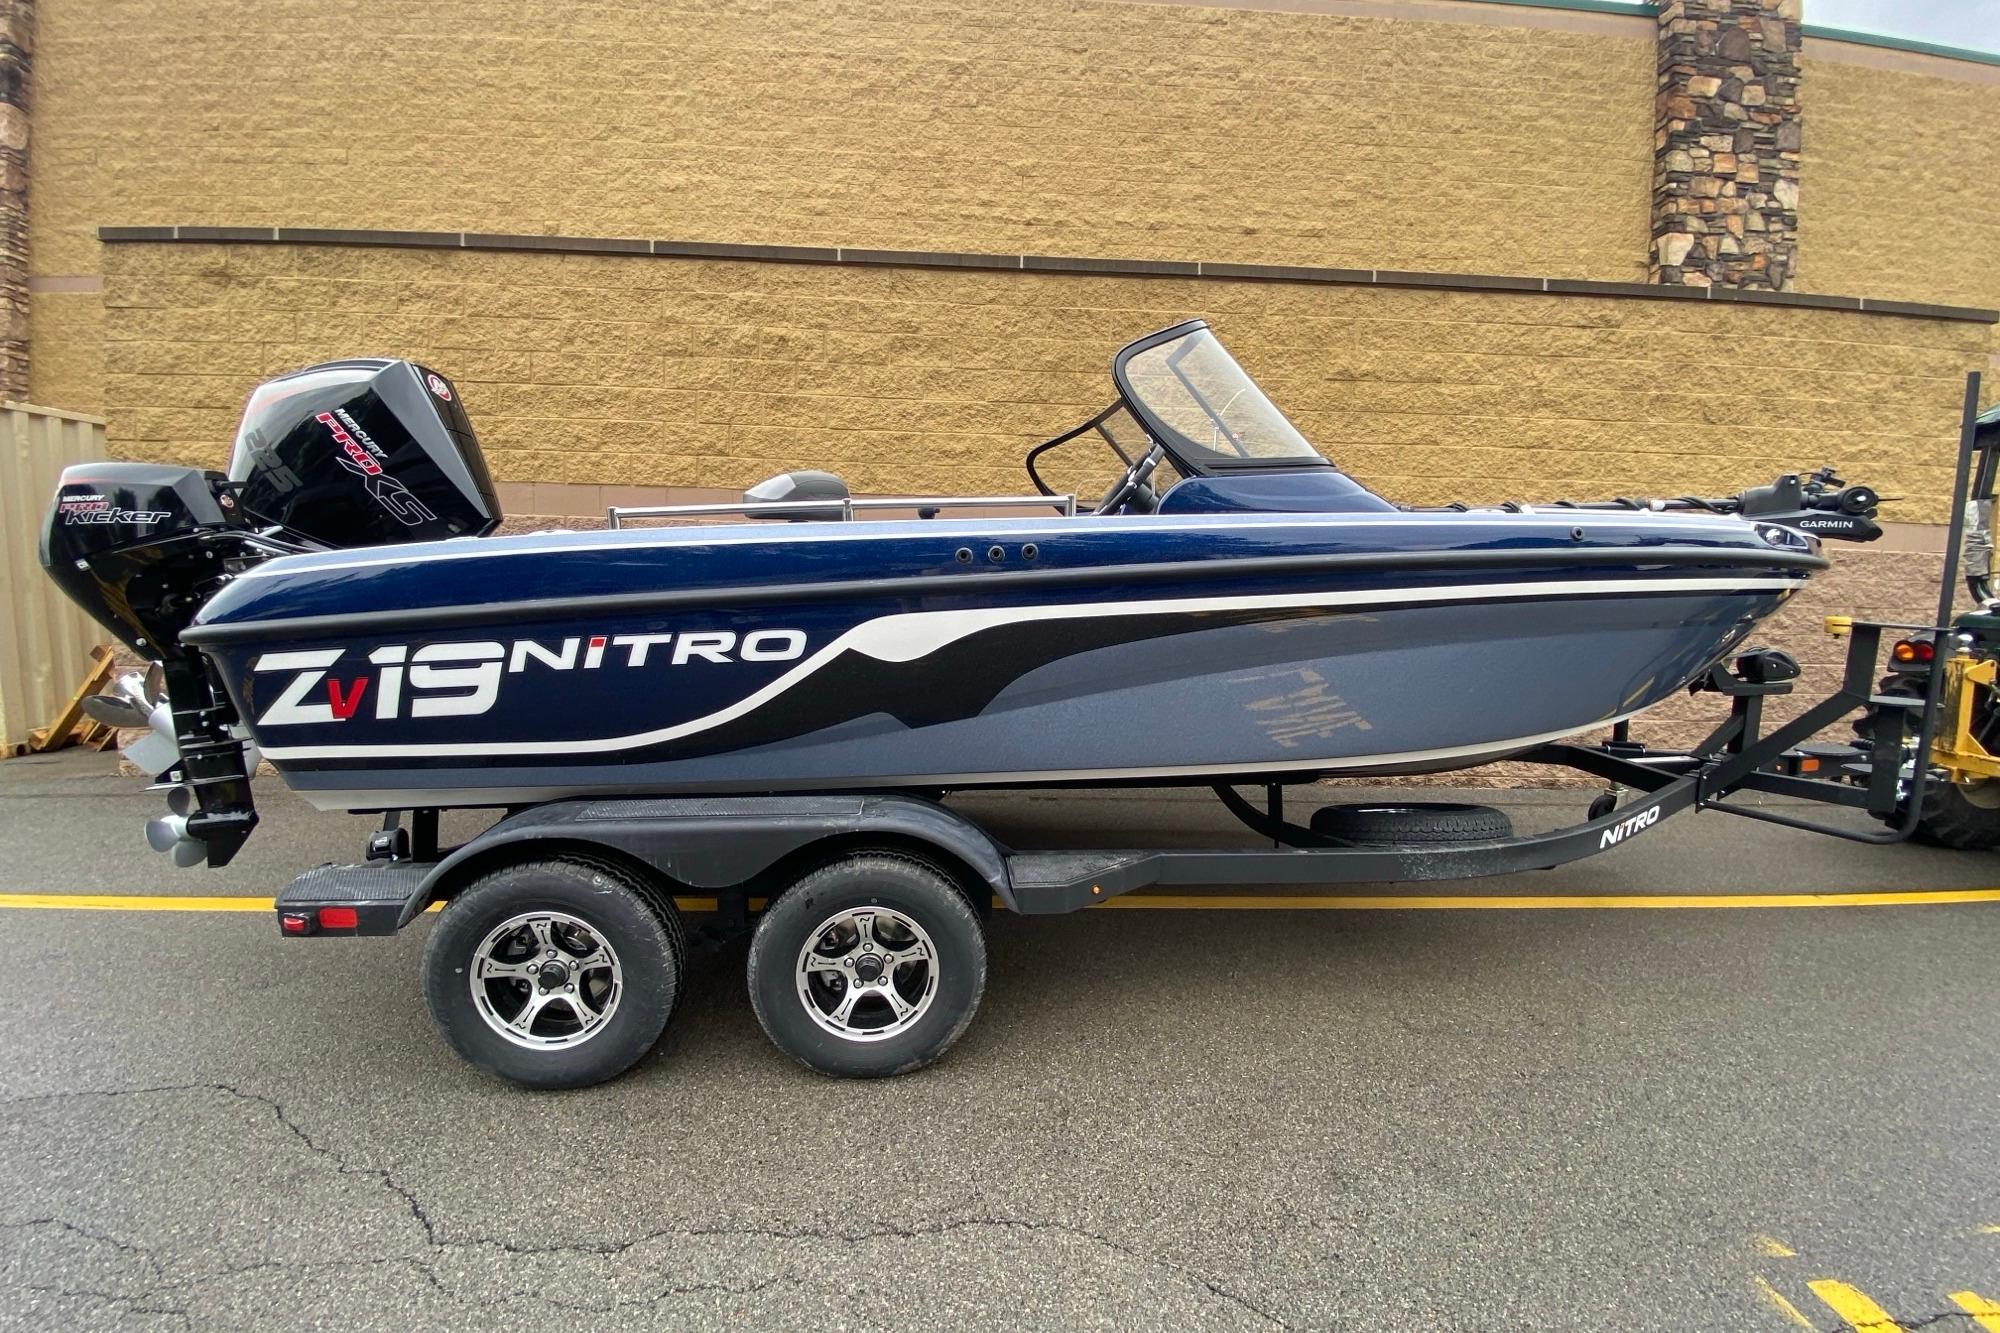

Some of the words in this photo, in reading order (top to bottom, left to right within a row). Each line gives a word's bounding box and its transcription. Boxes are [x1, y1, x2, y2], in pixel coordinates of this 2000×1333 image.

[315, 412, 382, 475] PRO
[334, 408, 388, 459] MERCURY
[62, 494, 105, 502] MERCURY
[336, 456, 438, 526] XS
[59, 501, 109, 513] PRO
[1800, 520, 1853, 528] GARMIN
